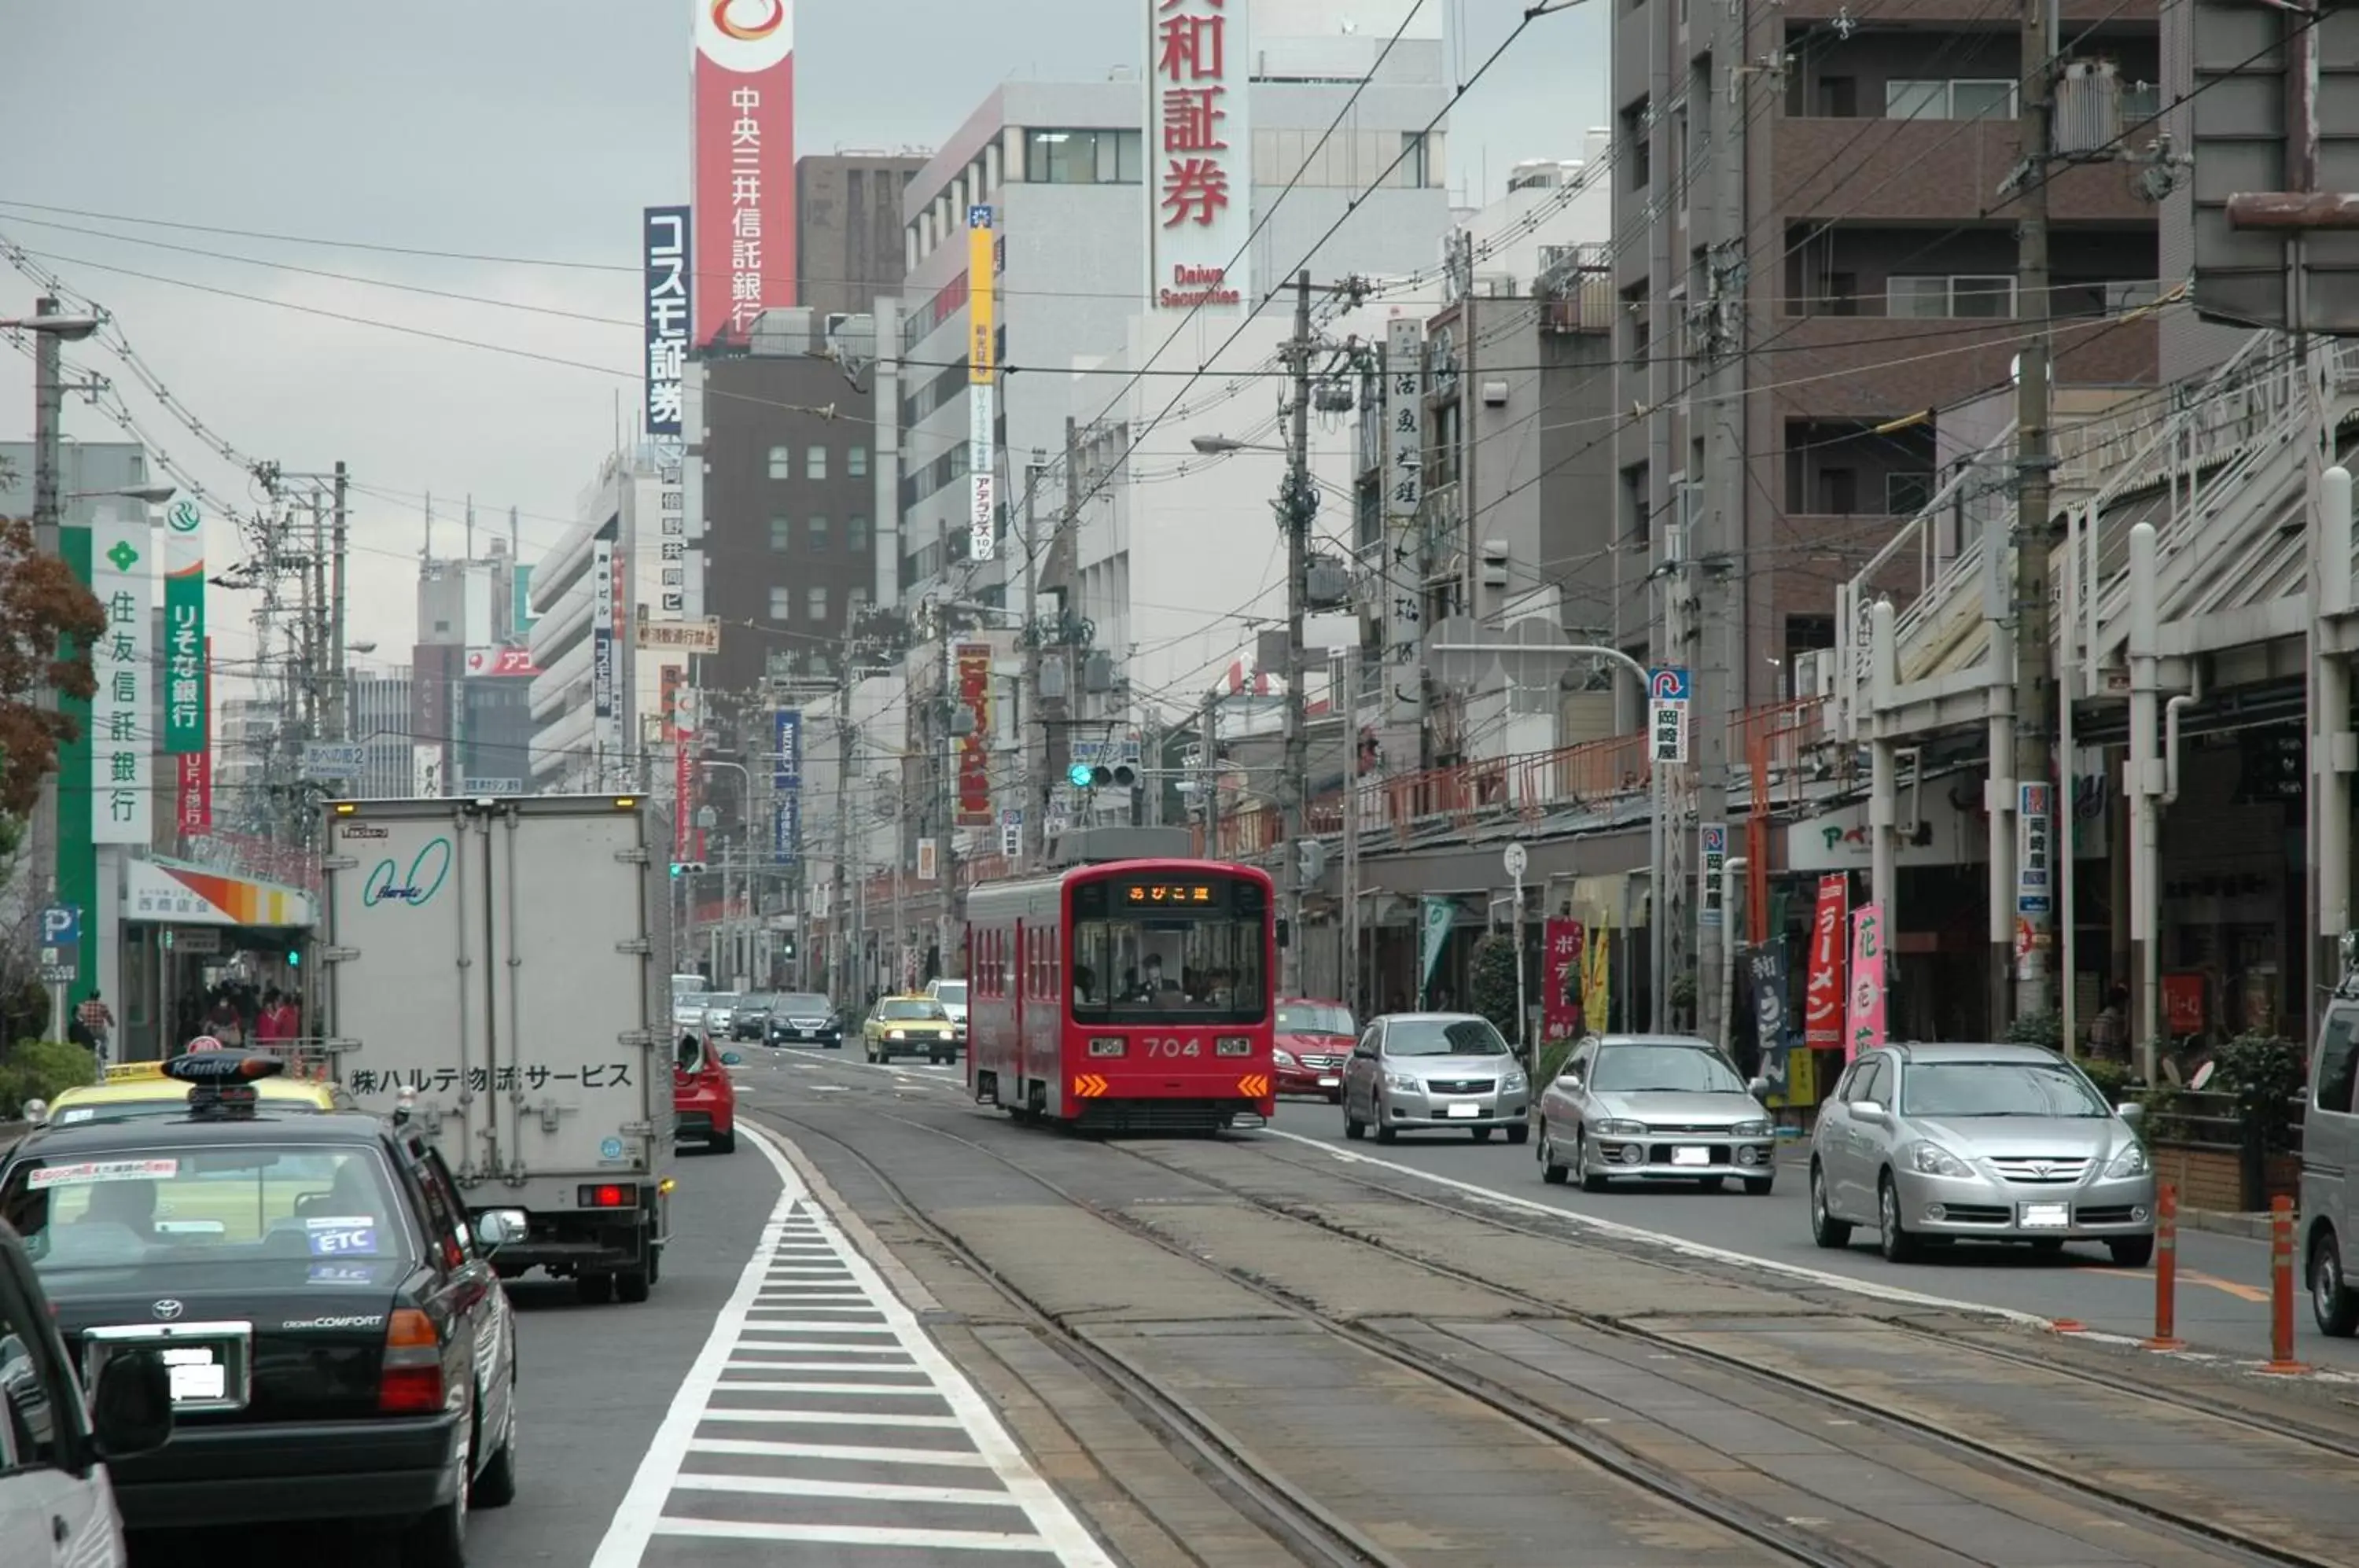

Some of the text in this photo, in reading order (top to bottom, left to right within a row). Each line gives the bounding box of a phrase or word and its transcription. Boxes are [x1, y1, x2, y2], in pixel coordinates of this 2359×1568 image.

[731, 86, 761, 333] 中央三井信託銀行
[1174, 264, 1224, 285] Daiwa
[1160, 287, 1240, 308] Securities
[650, 215, 687, 424] コスモ証券
[171, 605, 198, 728] りそな銀行
[110, 591, 136, 823] 住友信託銀行
[1129, 886, 1209, 900] あびこ道
[45, 909, 72, 942] P
[1805, 906, 1838, 1021] ラーメン
[1143, 1037, 1201, 1058] 704
[318, 1229, 370, 1252] ETC
[314, 1315, 384, 1327] COMFORT
